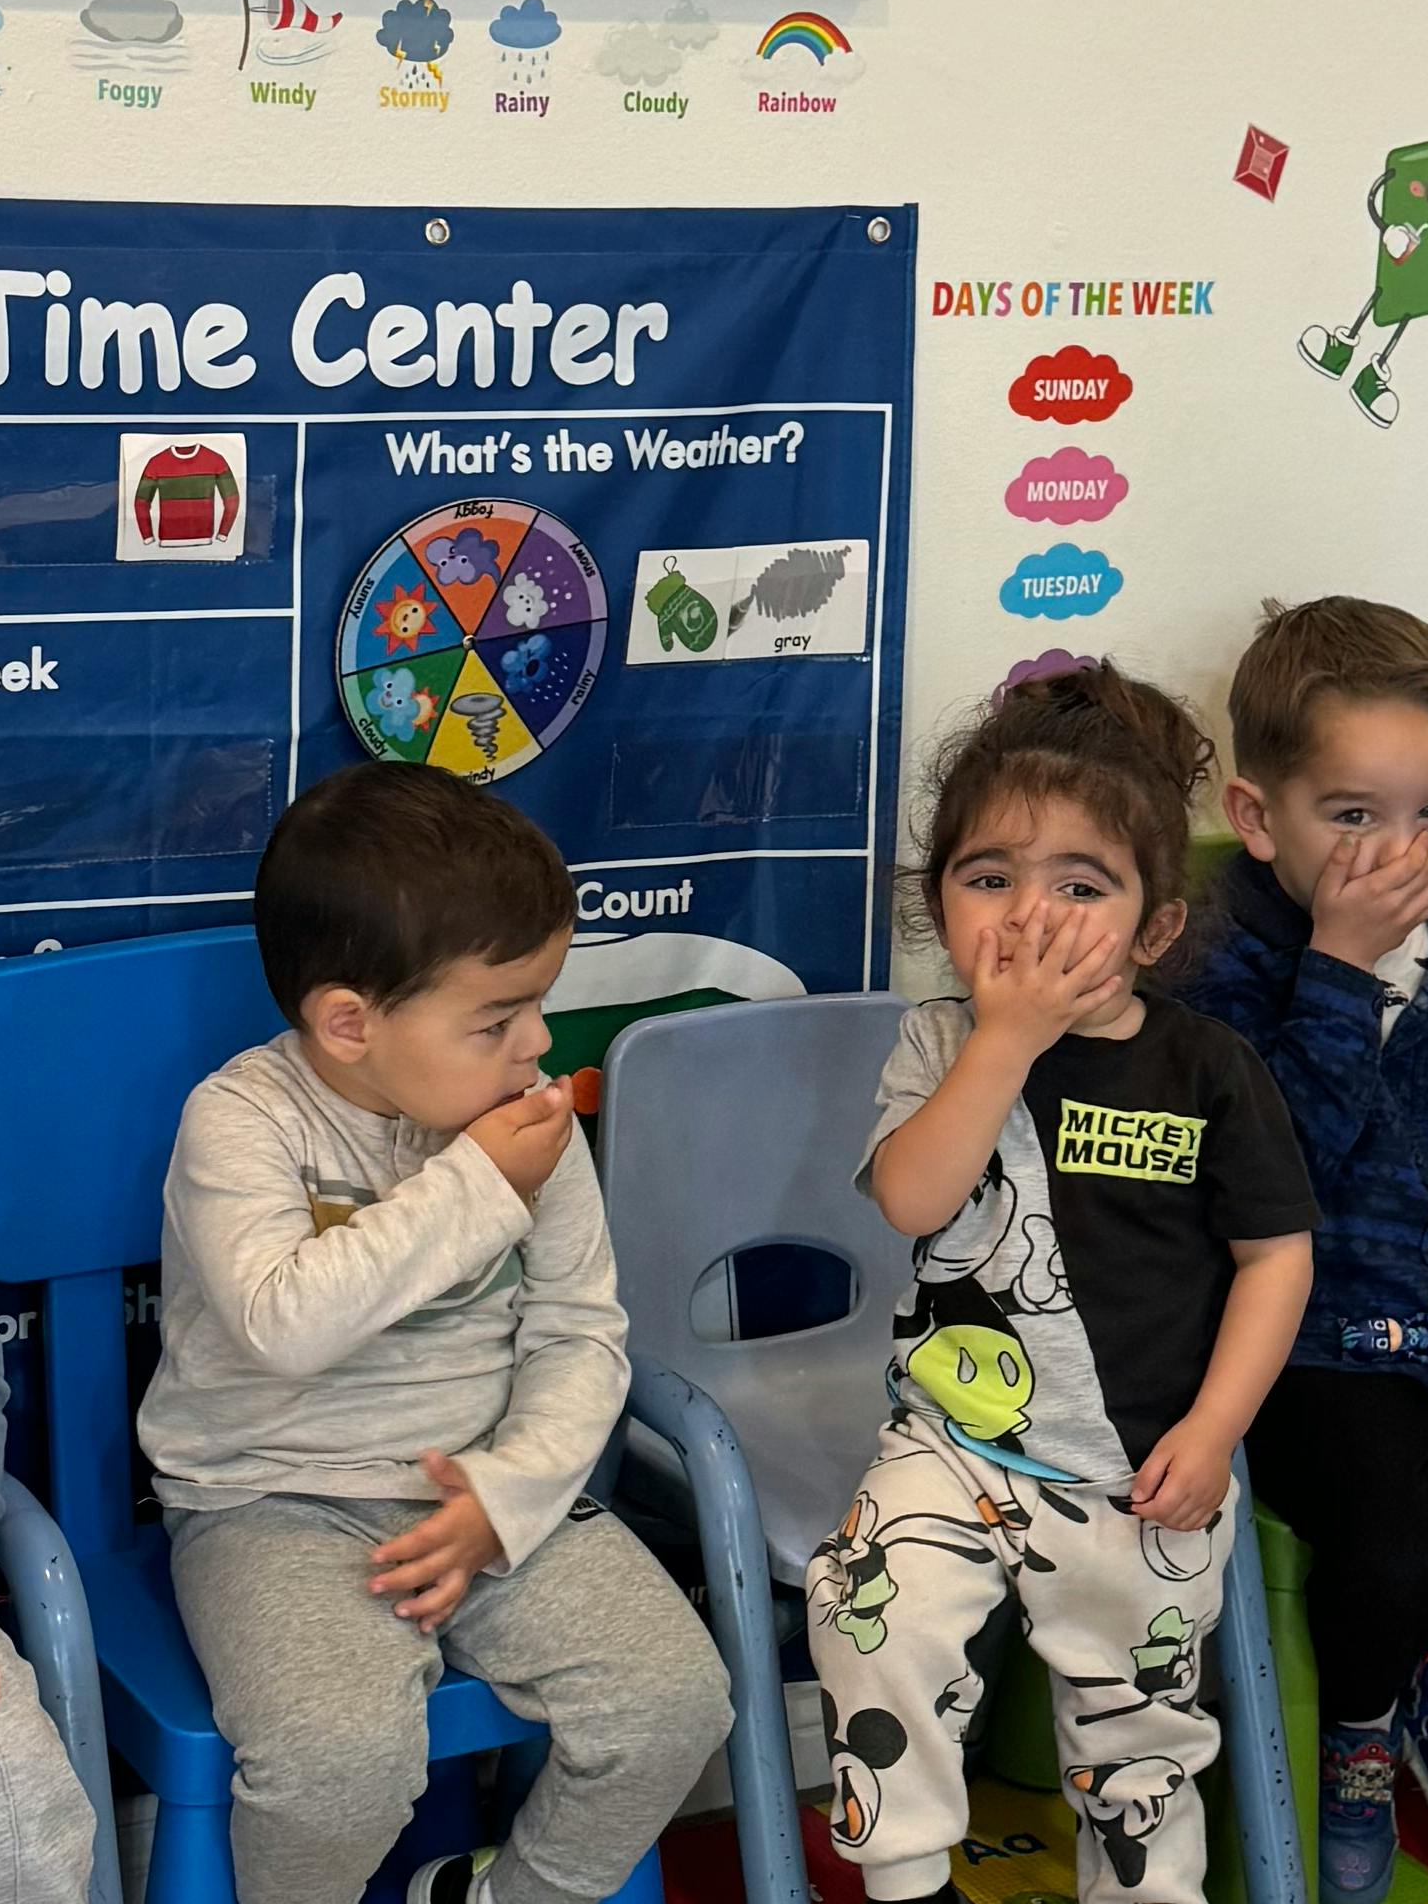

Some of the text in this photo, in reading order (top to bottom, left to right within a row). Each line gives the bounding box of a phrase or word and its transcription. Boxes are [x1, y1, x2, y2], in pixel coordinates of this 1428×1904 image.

[97, 79, 163, 109] Foggy
[250, 81, 317, 112] Windy
[378, 86, 450, 114] Stormy
[495, 92, 550, 117] Rainy
[623, 91, 689, 119] Cloudy
[757, 92, 837, 114] Rainbow
[931, 280, 1216, 317] DAYS OF THE WEEK
[291, 271, 670, 389] Center
[1033, 378, 1110, 402] SUNDAY
[385, 420, 805, 477] What's the Weather?
[1026, 479, 1109, 503] MONDAY
[454, 504, 495, 520] foggy
[568, 541, 597, 580] snowy
[349, 576, 376, 620] sunny
[1022, 573, 1103, 599] TUESDAY
[774, 632, 812, 653] gray
[571, 668, 596, 706] rainy
[357, 716, 389, 759] cloudy
[576, 878, 694, 920] Count
[1065, 1109, 1199, 1151] MICKEY
[1061, 1138, 1196, 1179] MOUSE
